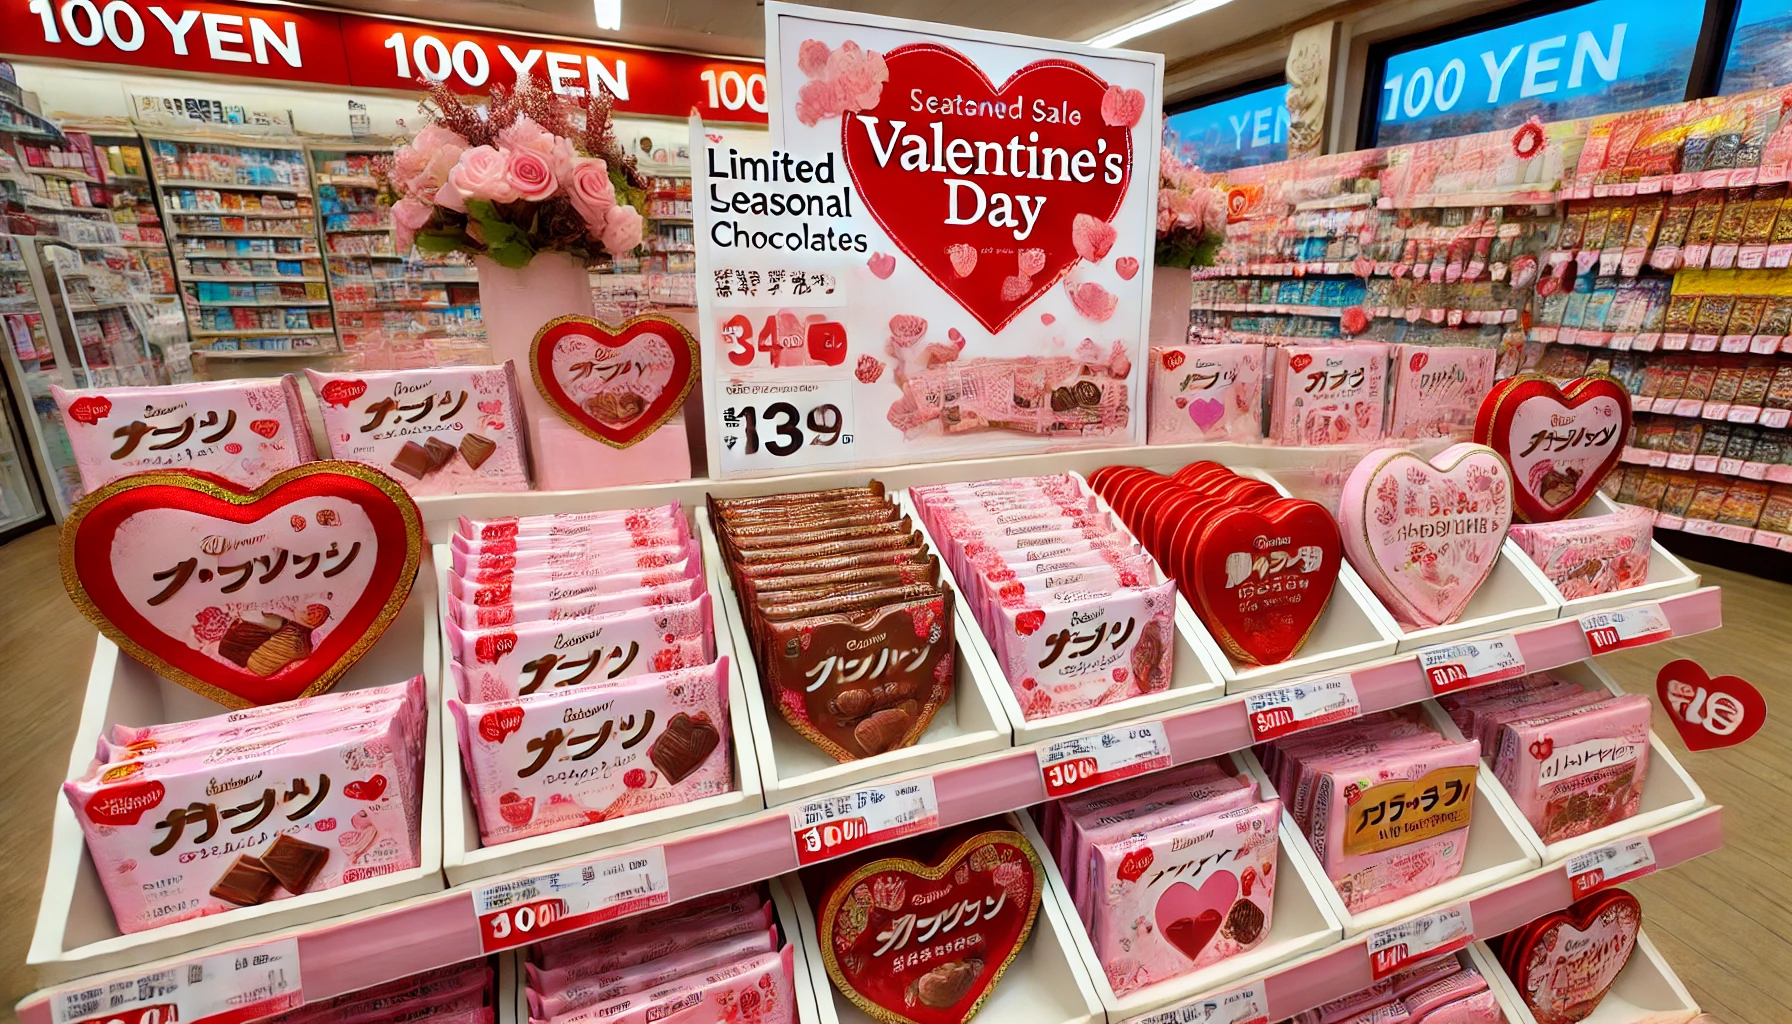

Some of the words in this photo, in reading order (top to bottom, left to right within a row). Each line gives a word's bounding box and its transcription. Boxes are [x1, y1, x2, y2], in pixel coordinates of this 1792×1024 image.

[30, 0, 145, 51] 100
[147, 6, 302, 67] YEN
[384, 32, 490, 87] 100
[497, 45, 630, 101] YEN
[700, 70, 768, 113] 100
[1384, 58, 1466, 121] 100
[1480, 23, 1628, 104] YEN
[708, 148, 835, 184] Limited
[856, 115, 1123, 184] Valentine's
[710, 184, 852, 218] Seasonal
[943, 178, 1047, 241] Day
[711, 221, 868, 253] Chocolates
